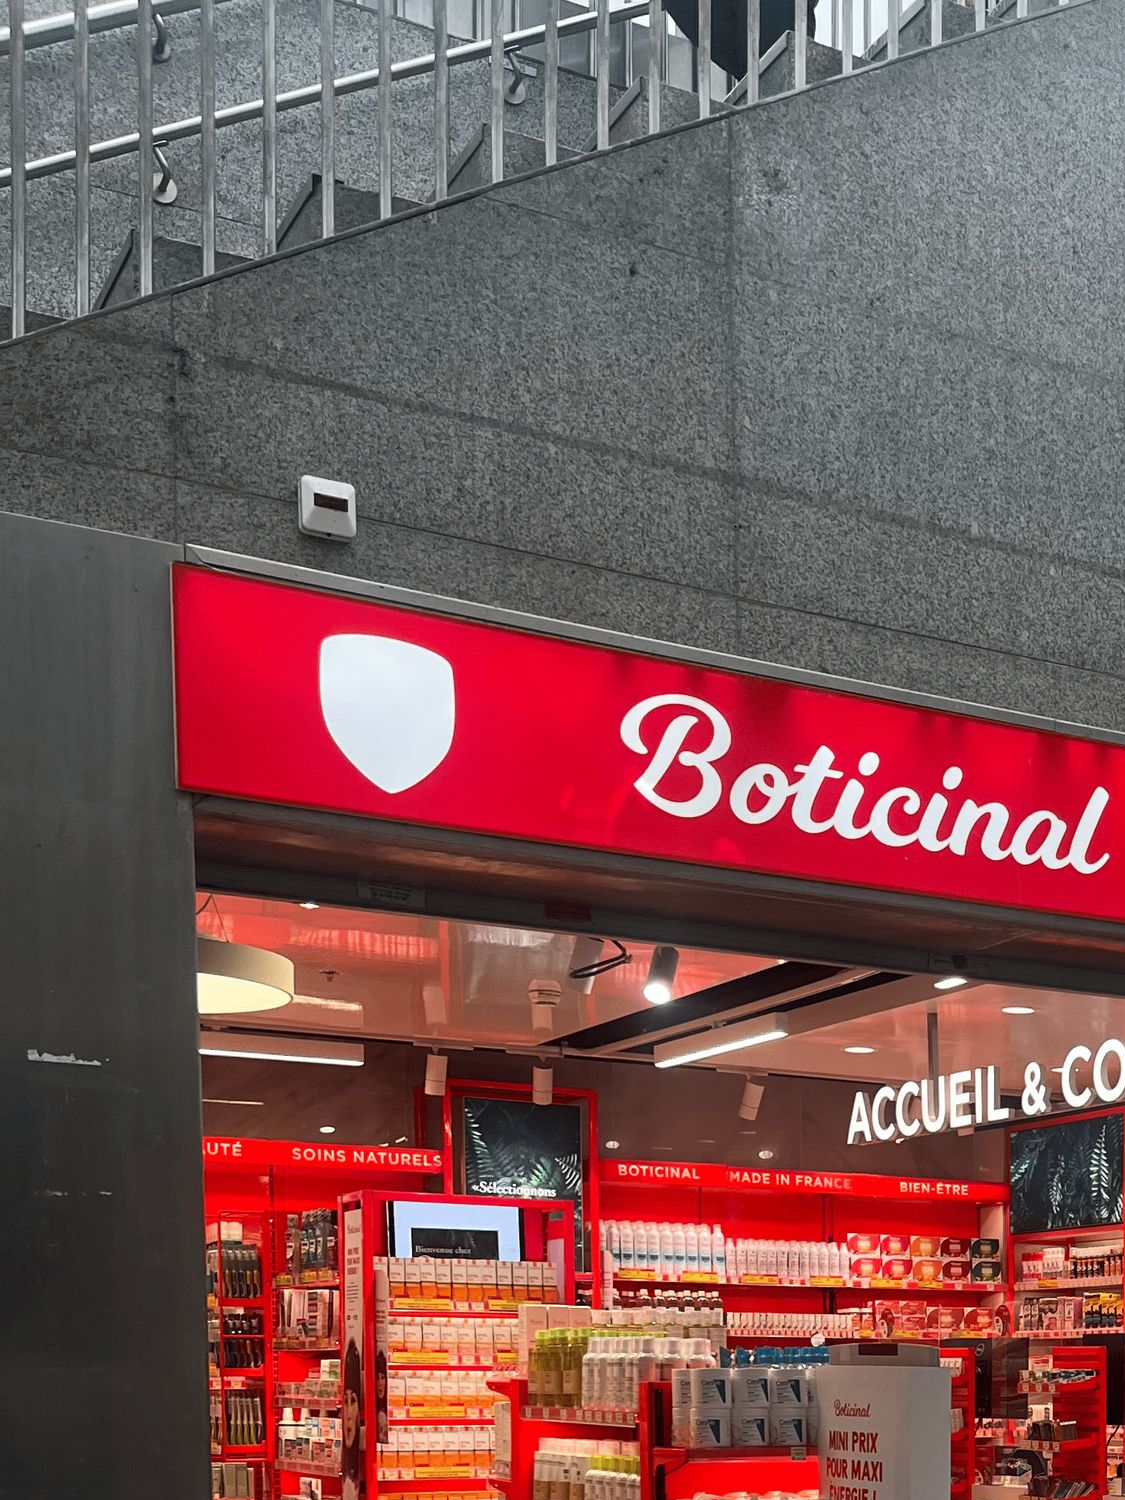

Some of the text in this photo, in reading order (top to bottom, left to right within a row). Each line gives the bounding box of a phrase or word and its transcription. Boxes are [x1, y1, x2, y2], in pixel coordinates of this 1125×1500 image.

[620, 693, 1110, 875] Boticinal
[847, 1064, 1011, 1145] ACCUEIL
[1022, 1061, 1047, 1117] &
[291, 1147, 443, 1167] SOINS NATURELS
[617, 1163, 700, 1180] BOTICINAL
[729, 1170, 852, 1190] MADE IN FRANCE
[899, 1181, 969, 1196] BIEN-ÊTRE
[415, 1245, 453, 1255] Bienvenue
[833, 1398, 871, 1419] Boticinal
[828, 1430, 878, 1454] MINI PRIX
[826, 1456, 883, 1483] POUR MAXI
